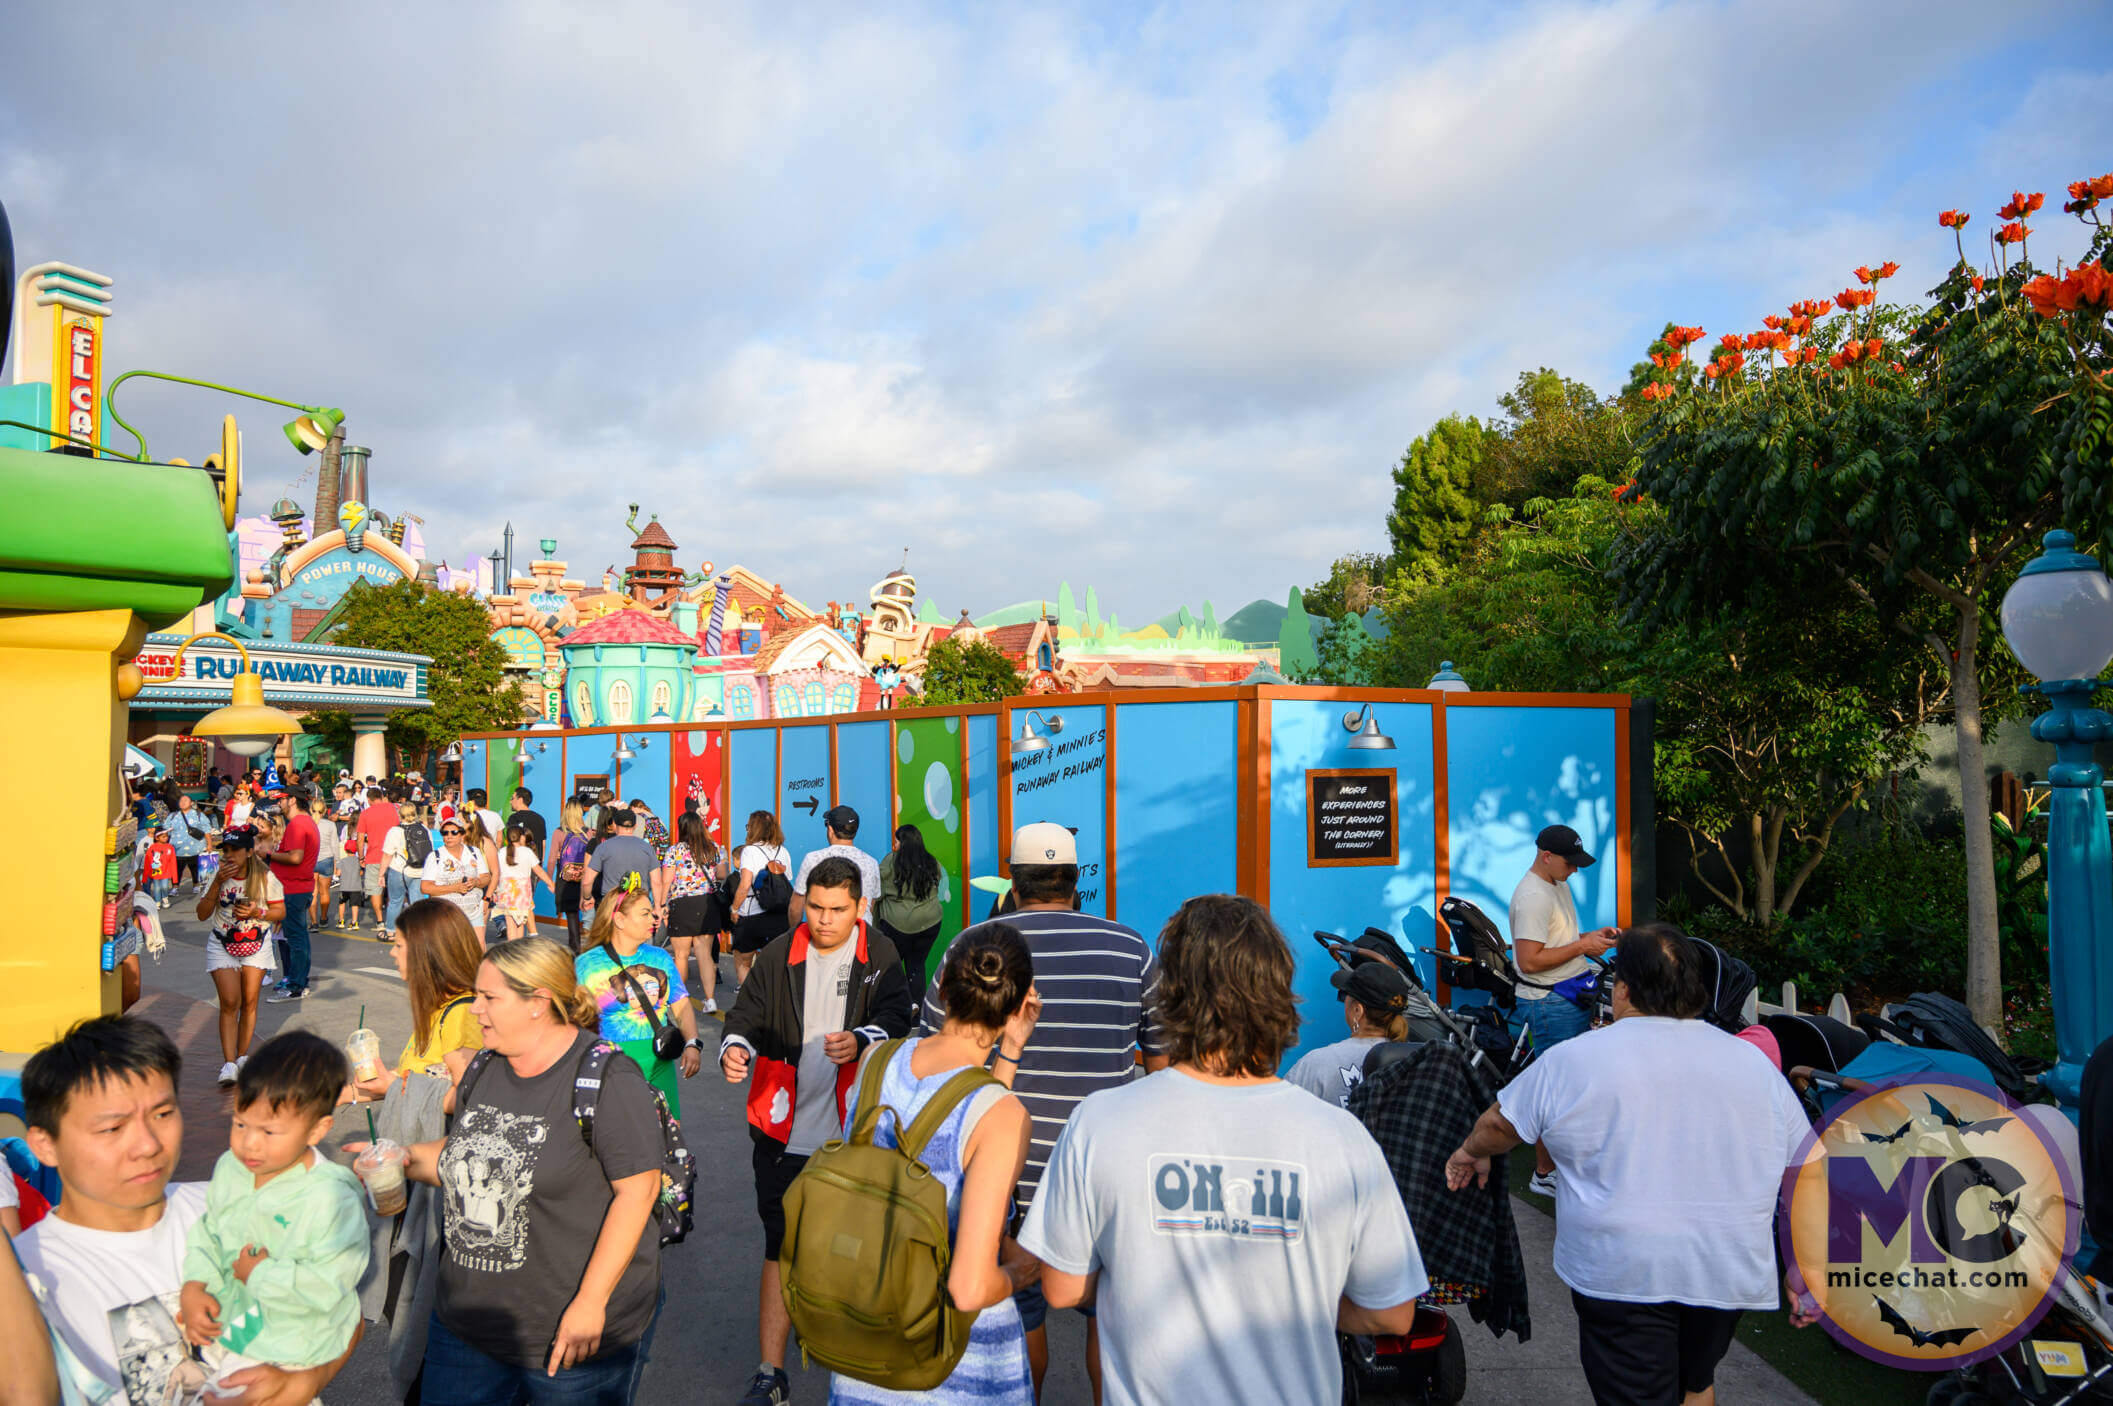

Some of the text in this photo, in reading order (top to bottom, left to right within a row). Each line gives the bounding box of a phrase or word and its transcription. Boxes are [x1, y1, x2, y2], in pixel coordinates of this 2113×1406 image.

[71, 331, 93, 380] EL
[301, 561, 352, 585] POWER
[130, 654, 177, 666] CKEY
[330, 664, 408, 690] RAILWAY
[1011, 728, 1106, 774] MICKEY & MINNIE'S
[1016, 753, 1105, 796] RUNAWAY RAILWAY
[787, 777, 825, 791] RESTROOMS
[1339, 786, 1368, 795] MORE
[1321, 800, 1387, 810] EXPERIENCES
[1320, 815, 1385, 825] JUST AROUND
[1323, 830, 1385, 840] THE CORNER!
